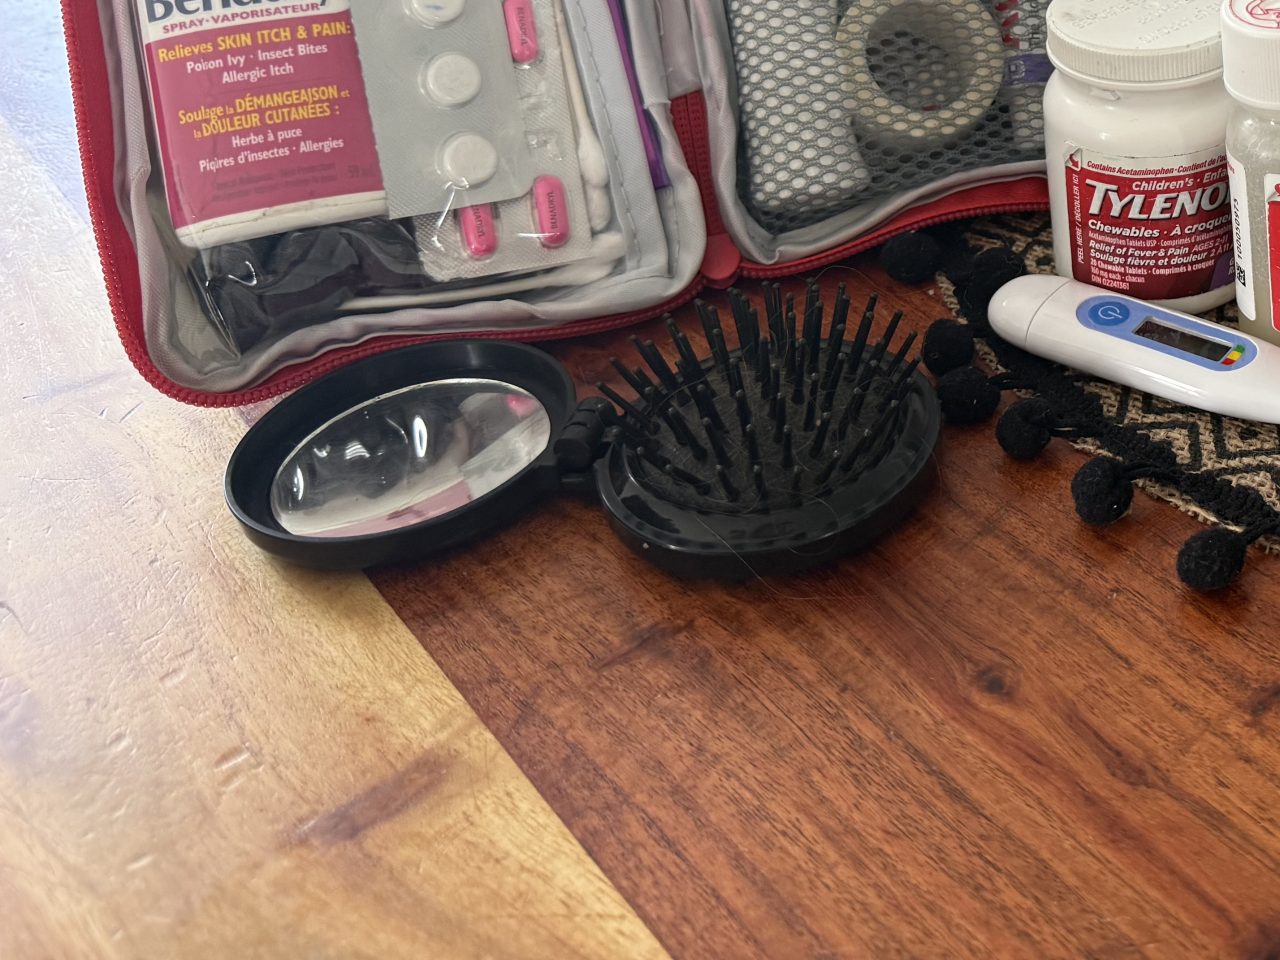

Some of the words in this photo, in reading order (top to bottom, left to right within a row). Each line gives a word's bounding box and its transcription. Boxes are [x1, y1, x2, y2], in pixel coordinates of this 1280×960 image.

[162, 17, 205, 34] SPRAY
[210, 2, 321, 25] VAPORISATEUR
[157, 40, 214, 63] Relieves
[216, 32, 252, 51] SKIN
[257, 26, 291, 45] ITCH
[296, 25, 308, 39] &
[312, 20, 351, 37] PAIN:
[186, 57, 224, 74] Poison
[227, 53, 246, 68] Ivy
[258, 47, 294, 61] Insect
[298, 43, 329, 56] Bites
[222, 66, 267, 85] Allergic
[270, 64, 294, 77] Itch
[232, 134, 264, 148] Herbe
[267, 129, 275, 142] à
[277, 127, 303, 140] puce
[237, 147, 290, 164] d'insectes
[300, 138, 344, 154] Allergies
[1087, 161, 1116, 173] Contains
[1116, 167, 1174, 177] Acetaminophen
[1177, 162, 1207, 173] Contient
[1088, 219, 1160, 238] Chewables
[1170, 225, 1183, 236] À
[1089, 240, 1115, 253] Relief
[1116, 243, 1126, 254] of
[1128, 245, 1159, 257] Fever
[1159, 248, 1166, 256] &
[1168, 247, 1189, 255] Pain
[1192, 241, 1213, 253] AGES
[1090, 249, 1125, 263] Soulage
[1127, 255, 1157, 266] fièvre
[1158, 257, 1169, 265] et
[1171, 252, 1207, 264] douleur
